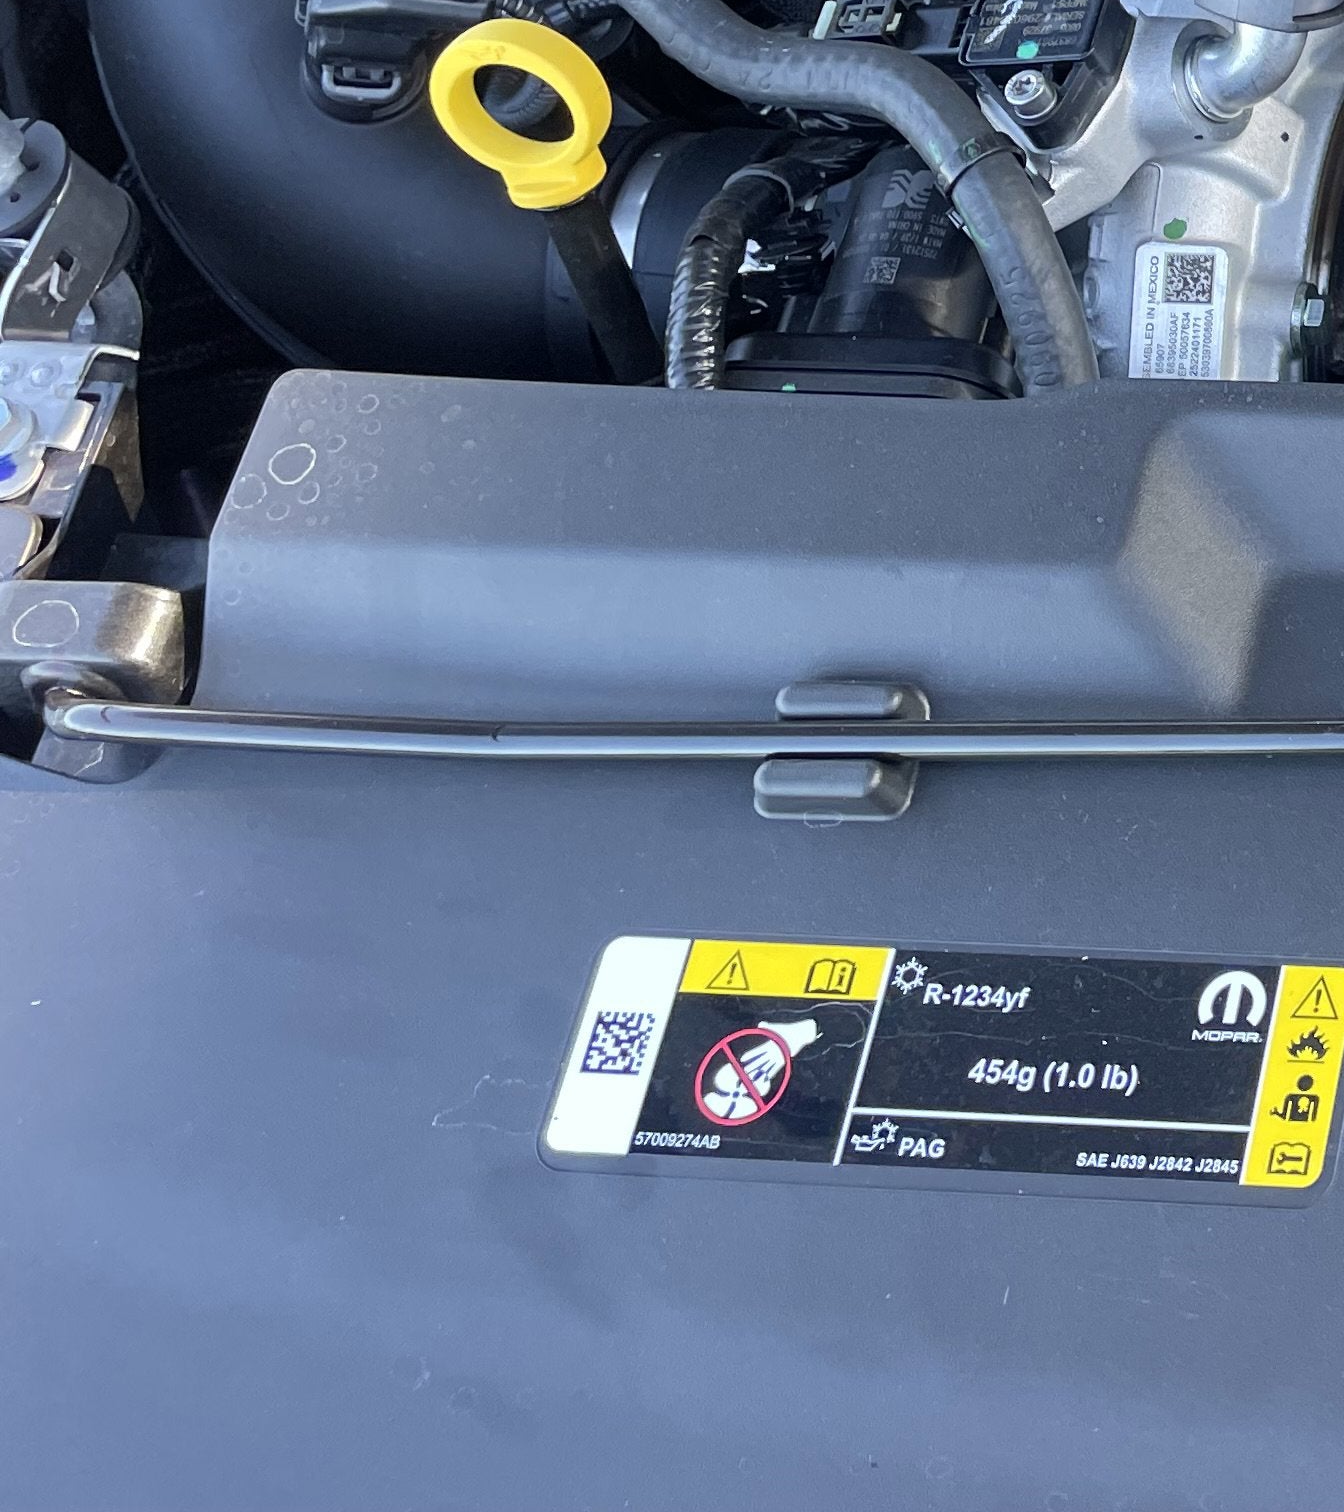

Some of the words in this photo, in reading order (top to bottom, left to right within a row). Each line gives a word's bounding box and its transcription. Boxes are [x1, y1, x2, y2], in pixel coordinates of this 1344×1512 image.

[1147, 255, 1159, 304] MEXICO
[1145, 307, 1156, 320] IN
[923, 983, 1031, 1013] R-1234yf
[1191, 1029, 1263, 1043] MOPAR
[968, 1057, 1037, 1092] 454g
[1043, 1061, 1096, 1093] (1.0
[1100, 1063, 1138, 1097] lb)
[634, 1131, 720, 1150] 57009274AB
[898, 1137, 946, 1159] PAG
[1076, 1152, 1109, 1168] SAE
[1111, 1153, 1147, 1170] J639
[1149, 1155, 1193, 1172] J2842
[1194, 1158, 1240, 1174] J2845
